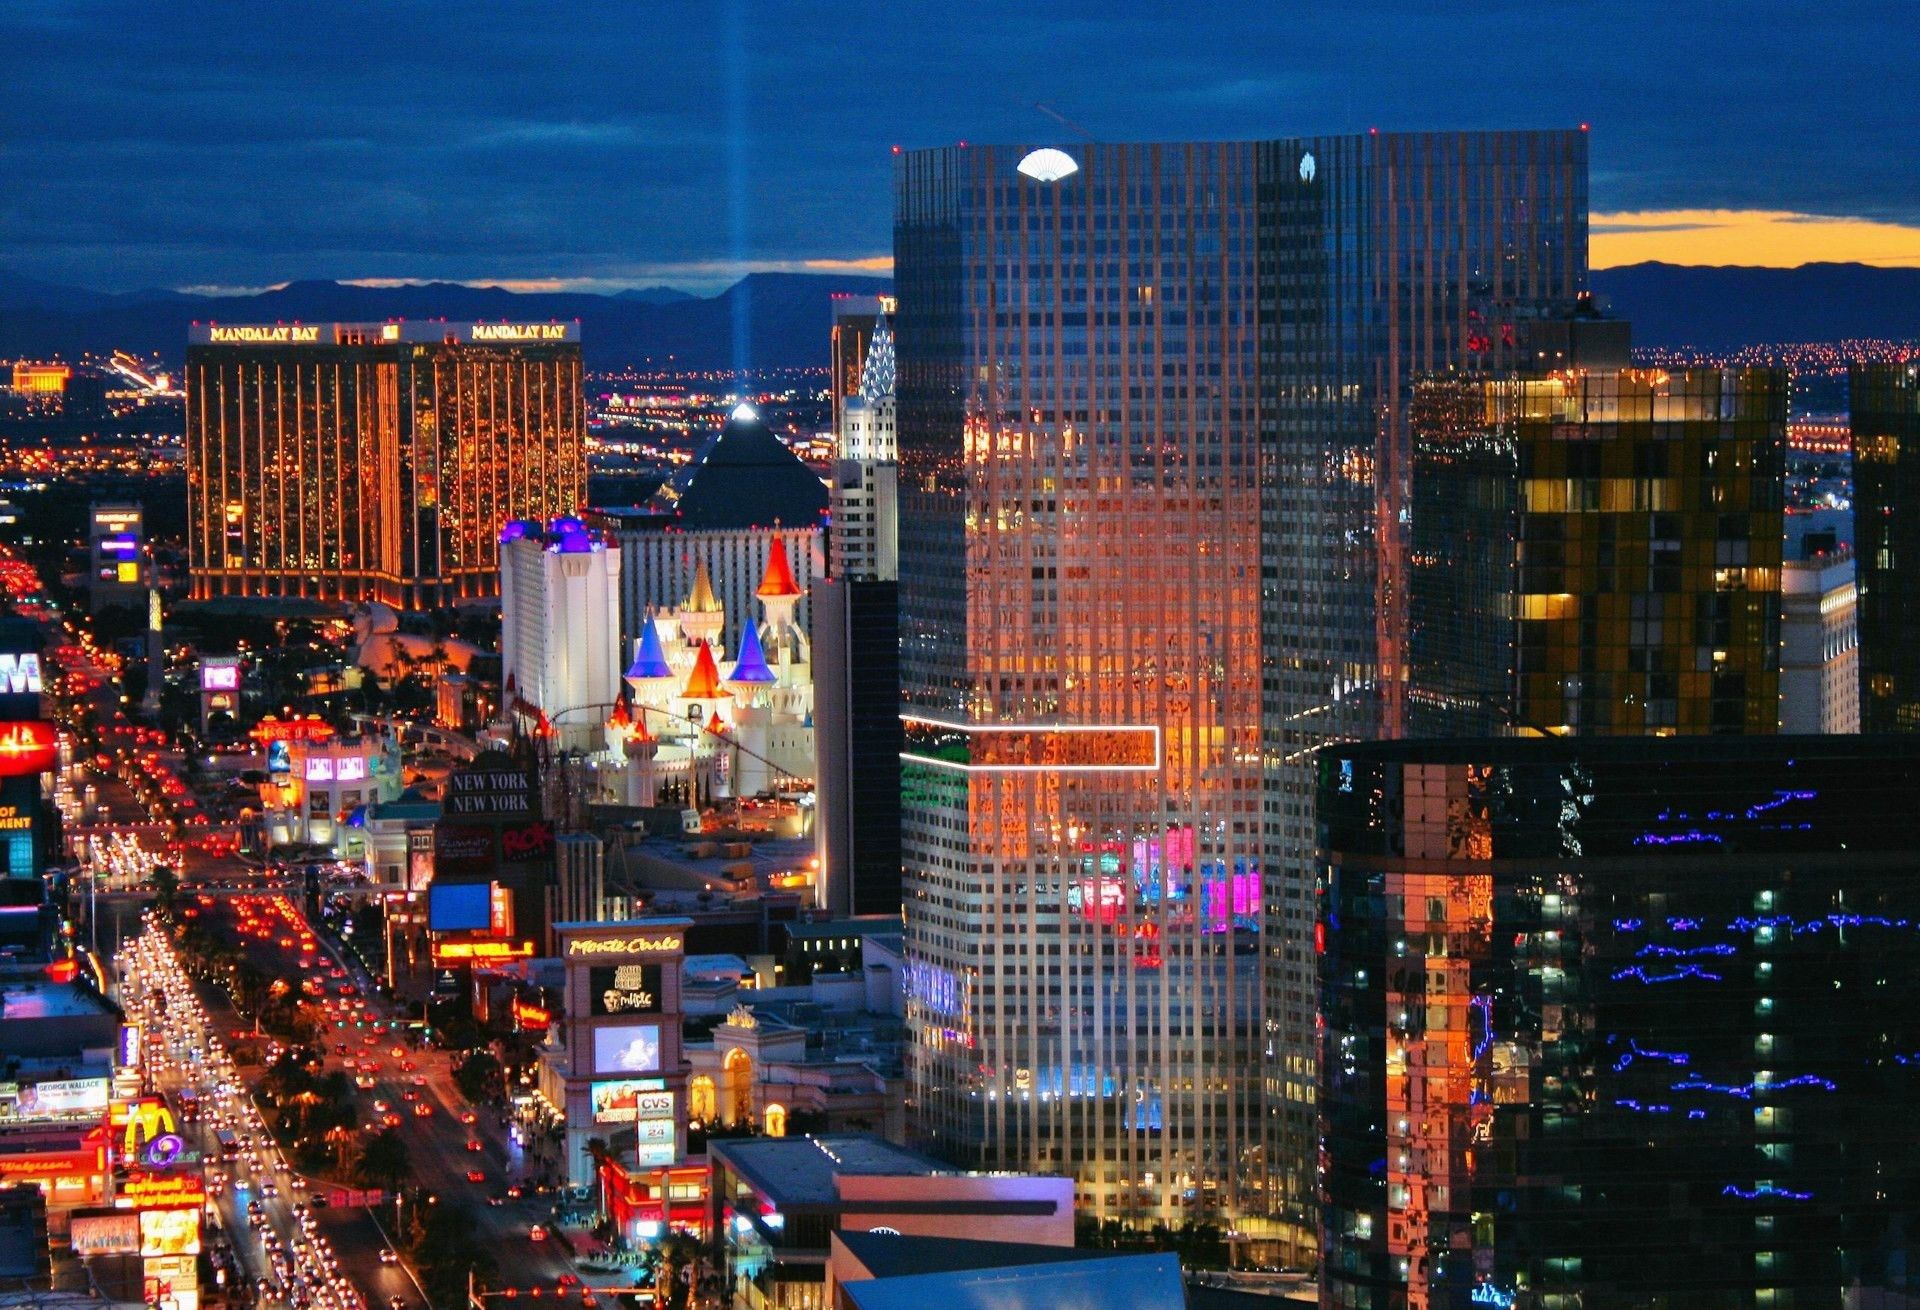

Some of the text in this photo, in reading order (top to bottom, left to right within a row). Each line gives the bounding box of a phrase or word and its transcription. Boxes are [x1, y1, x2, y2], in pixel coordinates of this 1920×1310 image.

[210, 326, 319, 341] MANDALAY BAY
[472, 325, 565, 339] MANDALAY BAY
[453, 772, 528, 791] NEW YORK
[453, 794, 529, 812] NEW YORK
[0, 806, 16, 818] OF
[568, 936, 680, 955] Monte Carlo
[39, 1080, 100, 1092] GEORGE WALLACE
[641, 1097, 670, 1109] CVS
[647, 1129, 664, 1137] 24
